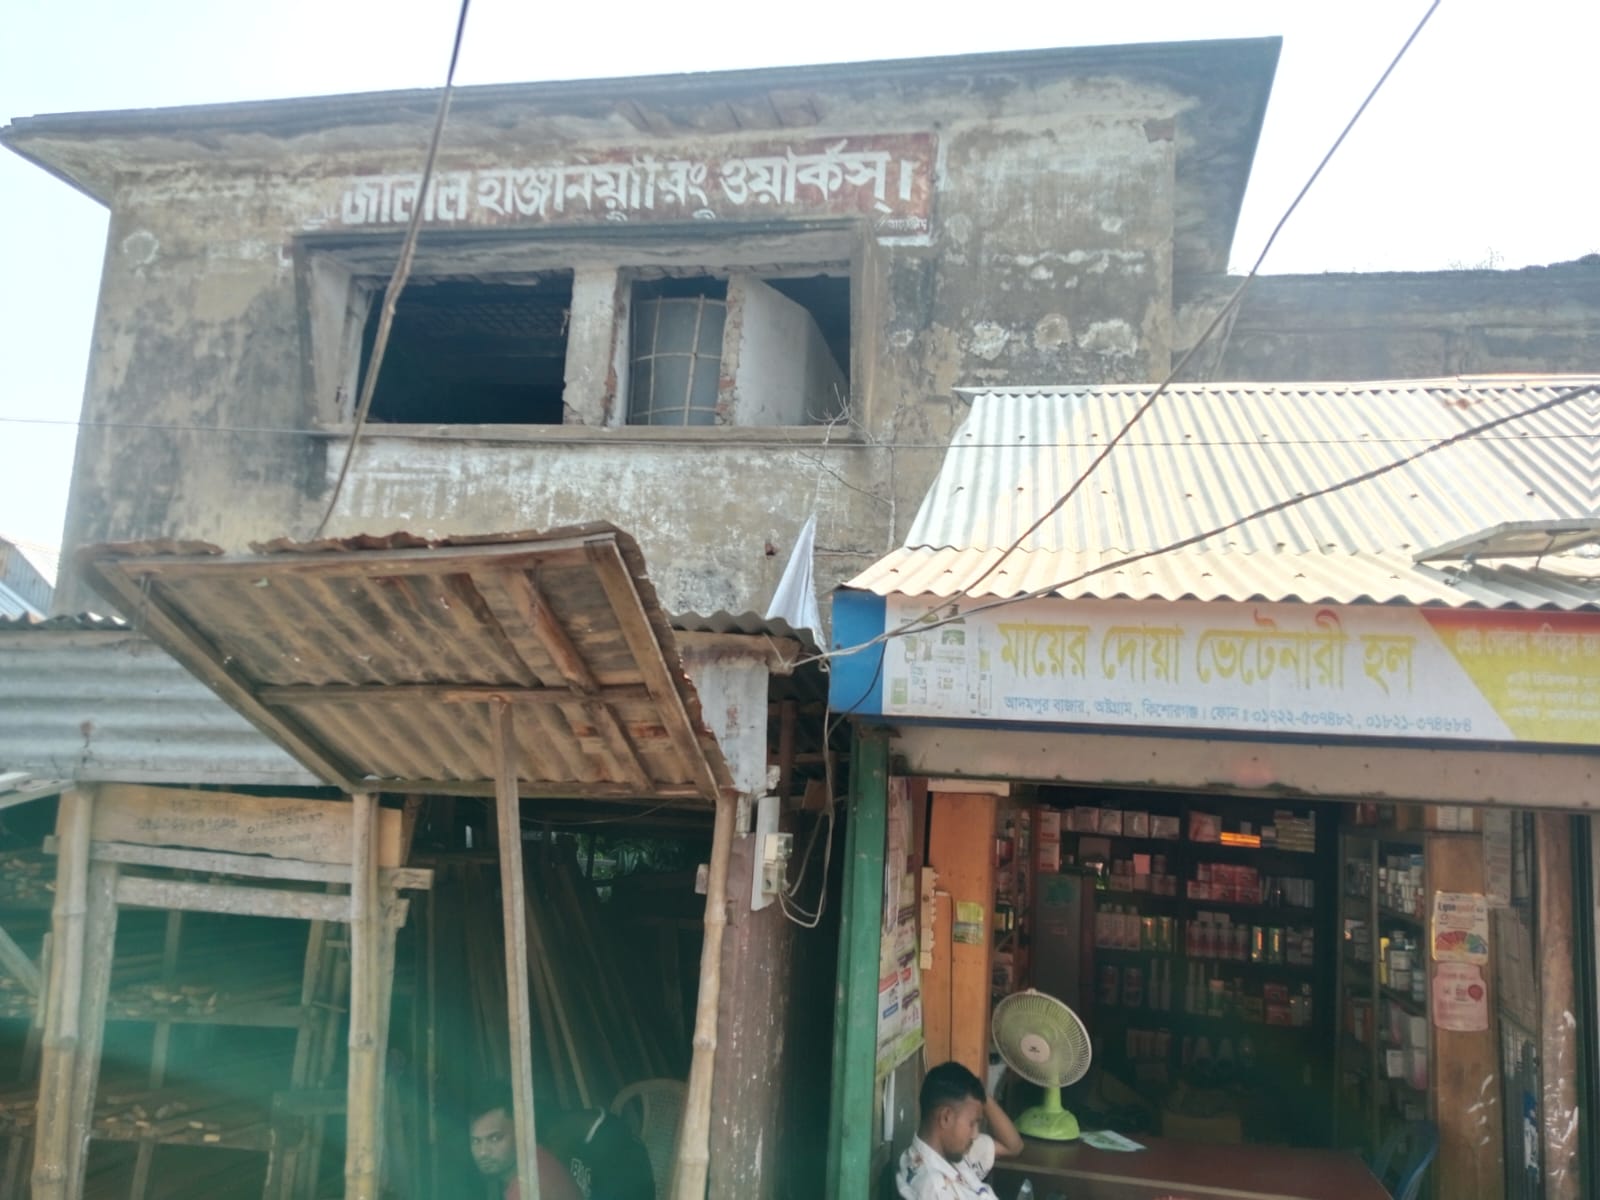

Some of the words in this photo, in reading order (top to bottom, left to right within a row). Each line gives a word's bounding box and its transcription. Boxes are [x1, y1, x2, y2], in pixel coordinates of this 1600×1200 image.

[341, 171, 472, 225] জালাল
[998, 619, 1091, 681] মায়ের
[1102, 622, 1185, 685] দোয়া
[1196, 608, 1348, 691] ভেটেনারী
[1360, 633, 1417, 698] হল
